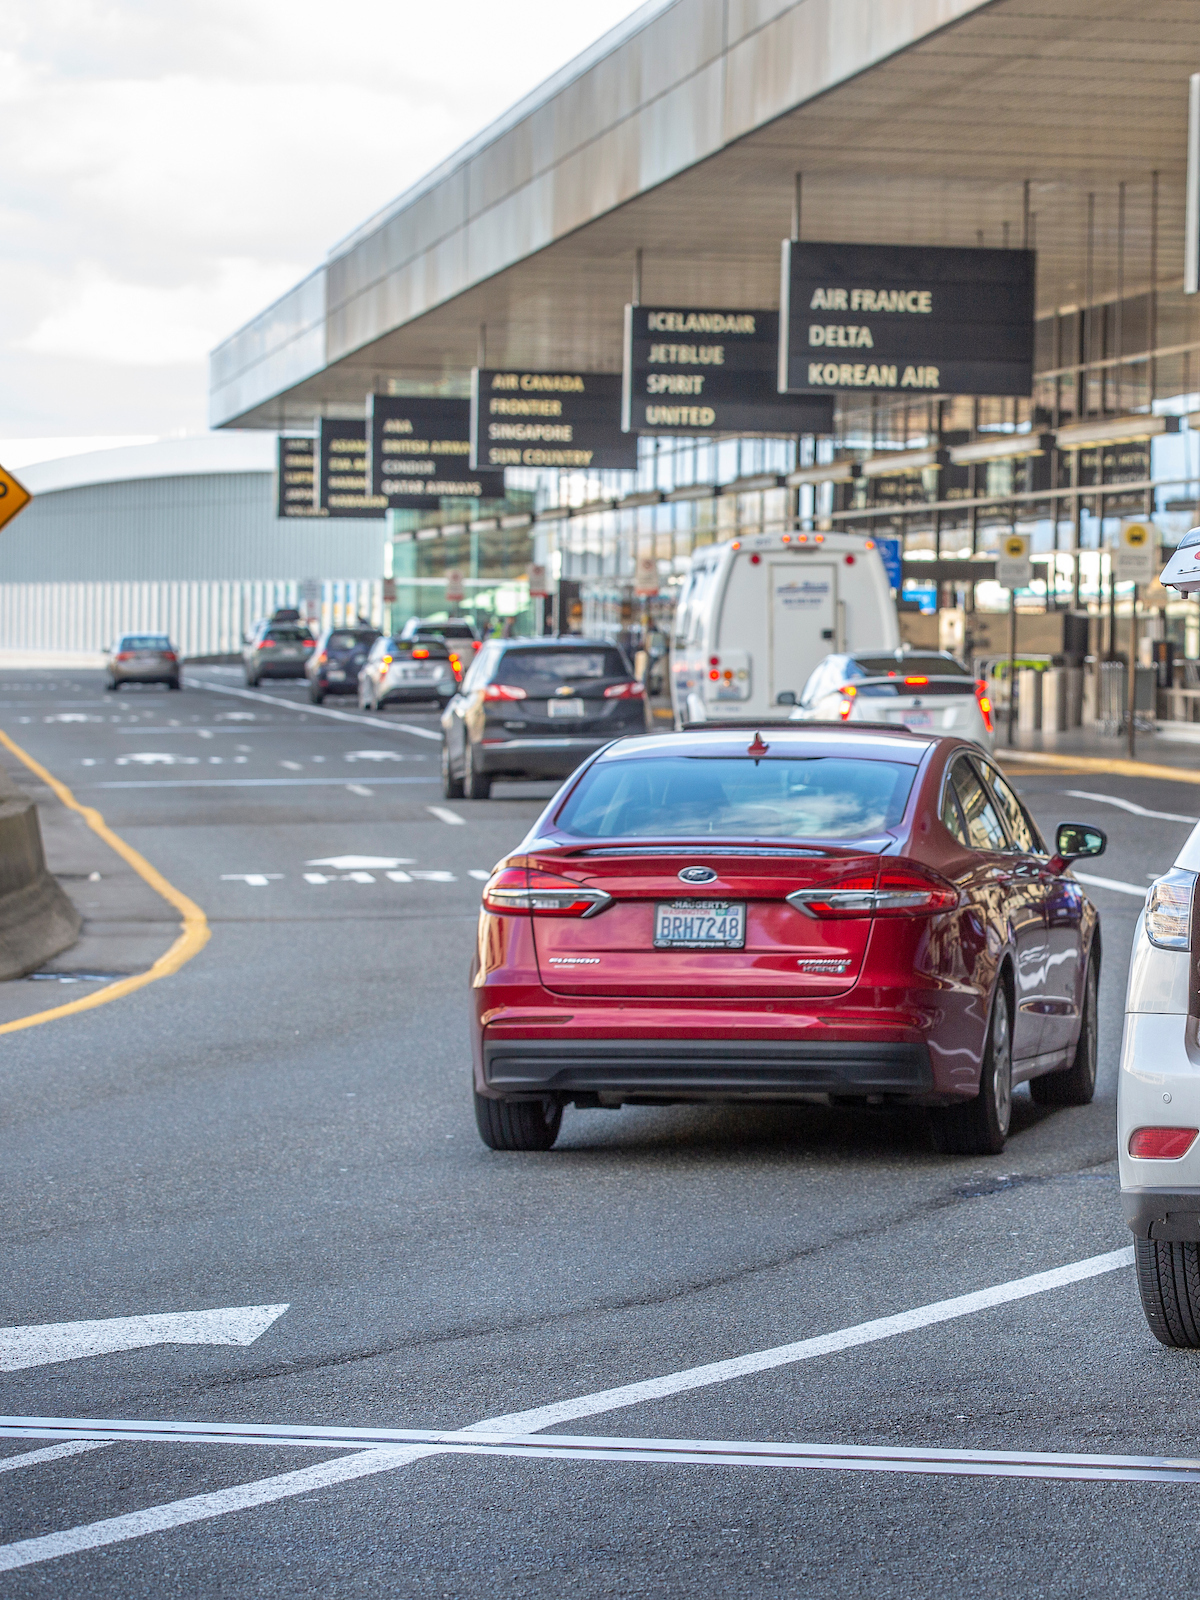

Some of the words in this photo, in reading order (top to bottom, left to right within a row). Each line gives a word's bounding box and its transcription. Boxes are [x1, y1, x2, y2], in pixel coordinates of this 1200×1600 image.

[810, 288, 848, 310] AIR
[850, 290, 932, 313] FRANCE
[648, 311, 755, 334] ICELANDAIR
[808, 325, 873, 348] DELTA
[647, 345, 725, 365] JETBLUE
[491, 374, 519, 391] AIR
[520, 375, 585, 393] CANADA
[647, 374, 705, 395] SPIRIT
[808, 363, 897, 387] KOREAN
[901, 366, 940, 388] AIR
[489, 399, 563, 417] FRONTIER
[646, 406, 716, 426] UNITED
[488, 423, 573, 442] SINGAPORE
[430, 440, 471, 456] AIRWA
[489, 447, 521, 465] SUN
[522, 449, 594, 468] COUNTRY
[660, 917, 739, 938] BRH7248
